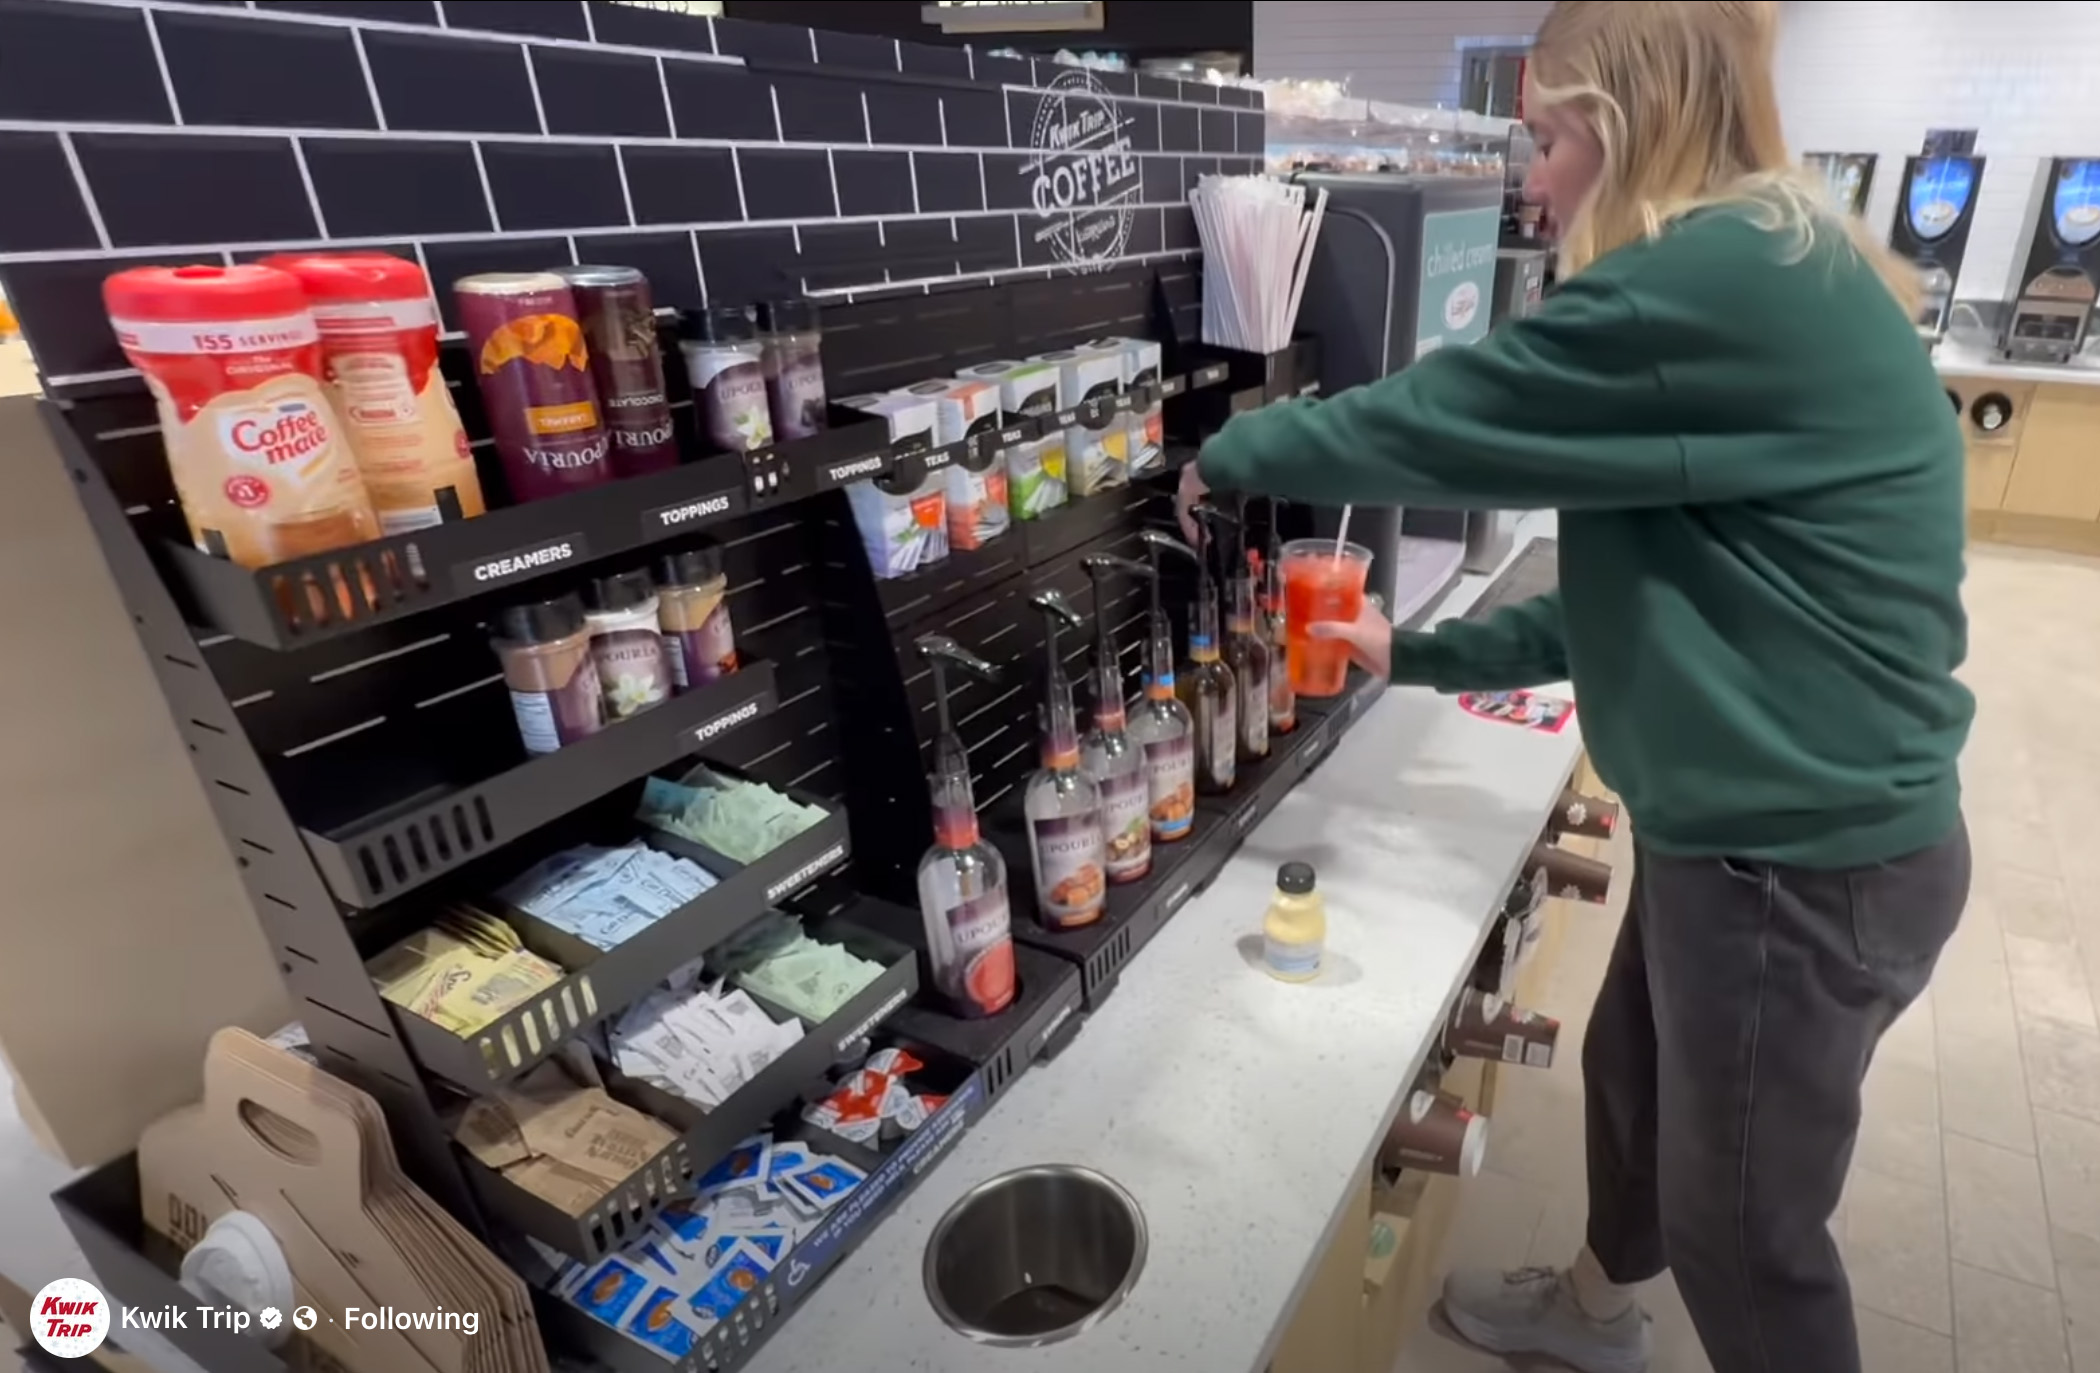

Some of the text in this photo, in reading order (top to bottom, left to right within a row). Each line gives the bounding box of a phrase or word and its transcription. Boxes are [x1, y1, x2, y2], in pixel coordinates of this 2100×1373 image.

[1032, 136, 1136, 218] COFFEE
[192, 334, 233, 351] 155
[231, 410, 318, 452] Coffee
[265, 425, 328, 464] mate
[829, 456, 882, 480] TOPPINGS
[924, 452, 950, 468] TEAS
[660, 496, 730, 526] TOPPINGS
[474, 543, 573, 582] CREAMERS
[695, 702, 758, 741] TOPPINGS
[767, 844, 844, 900] SWEETENERS
